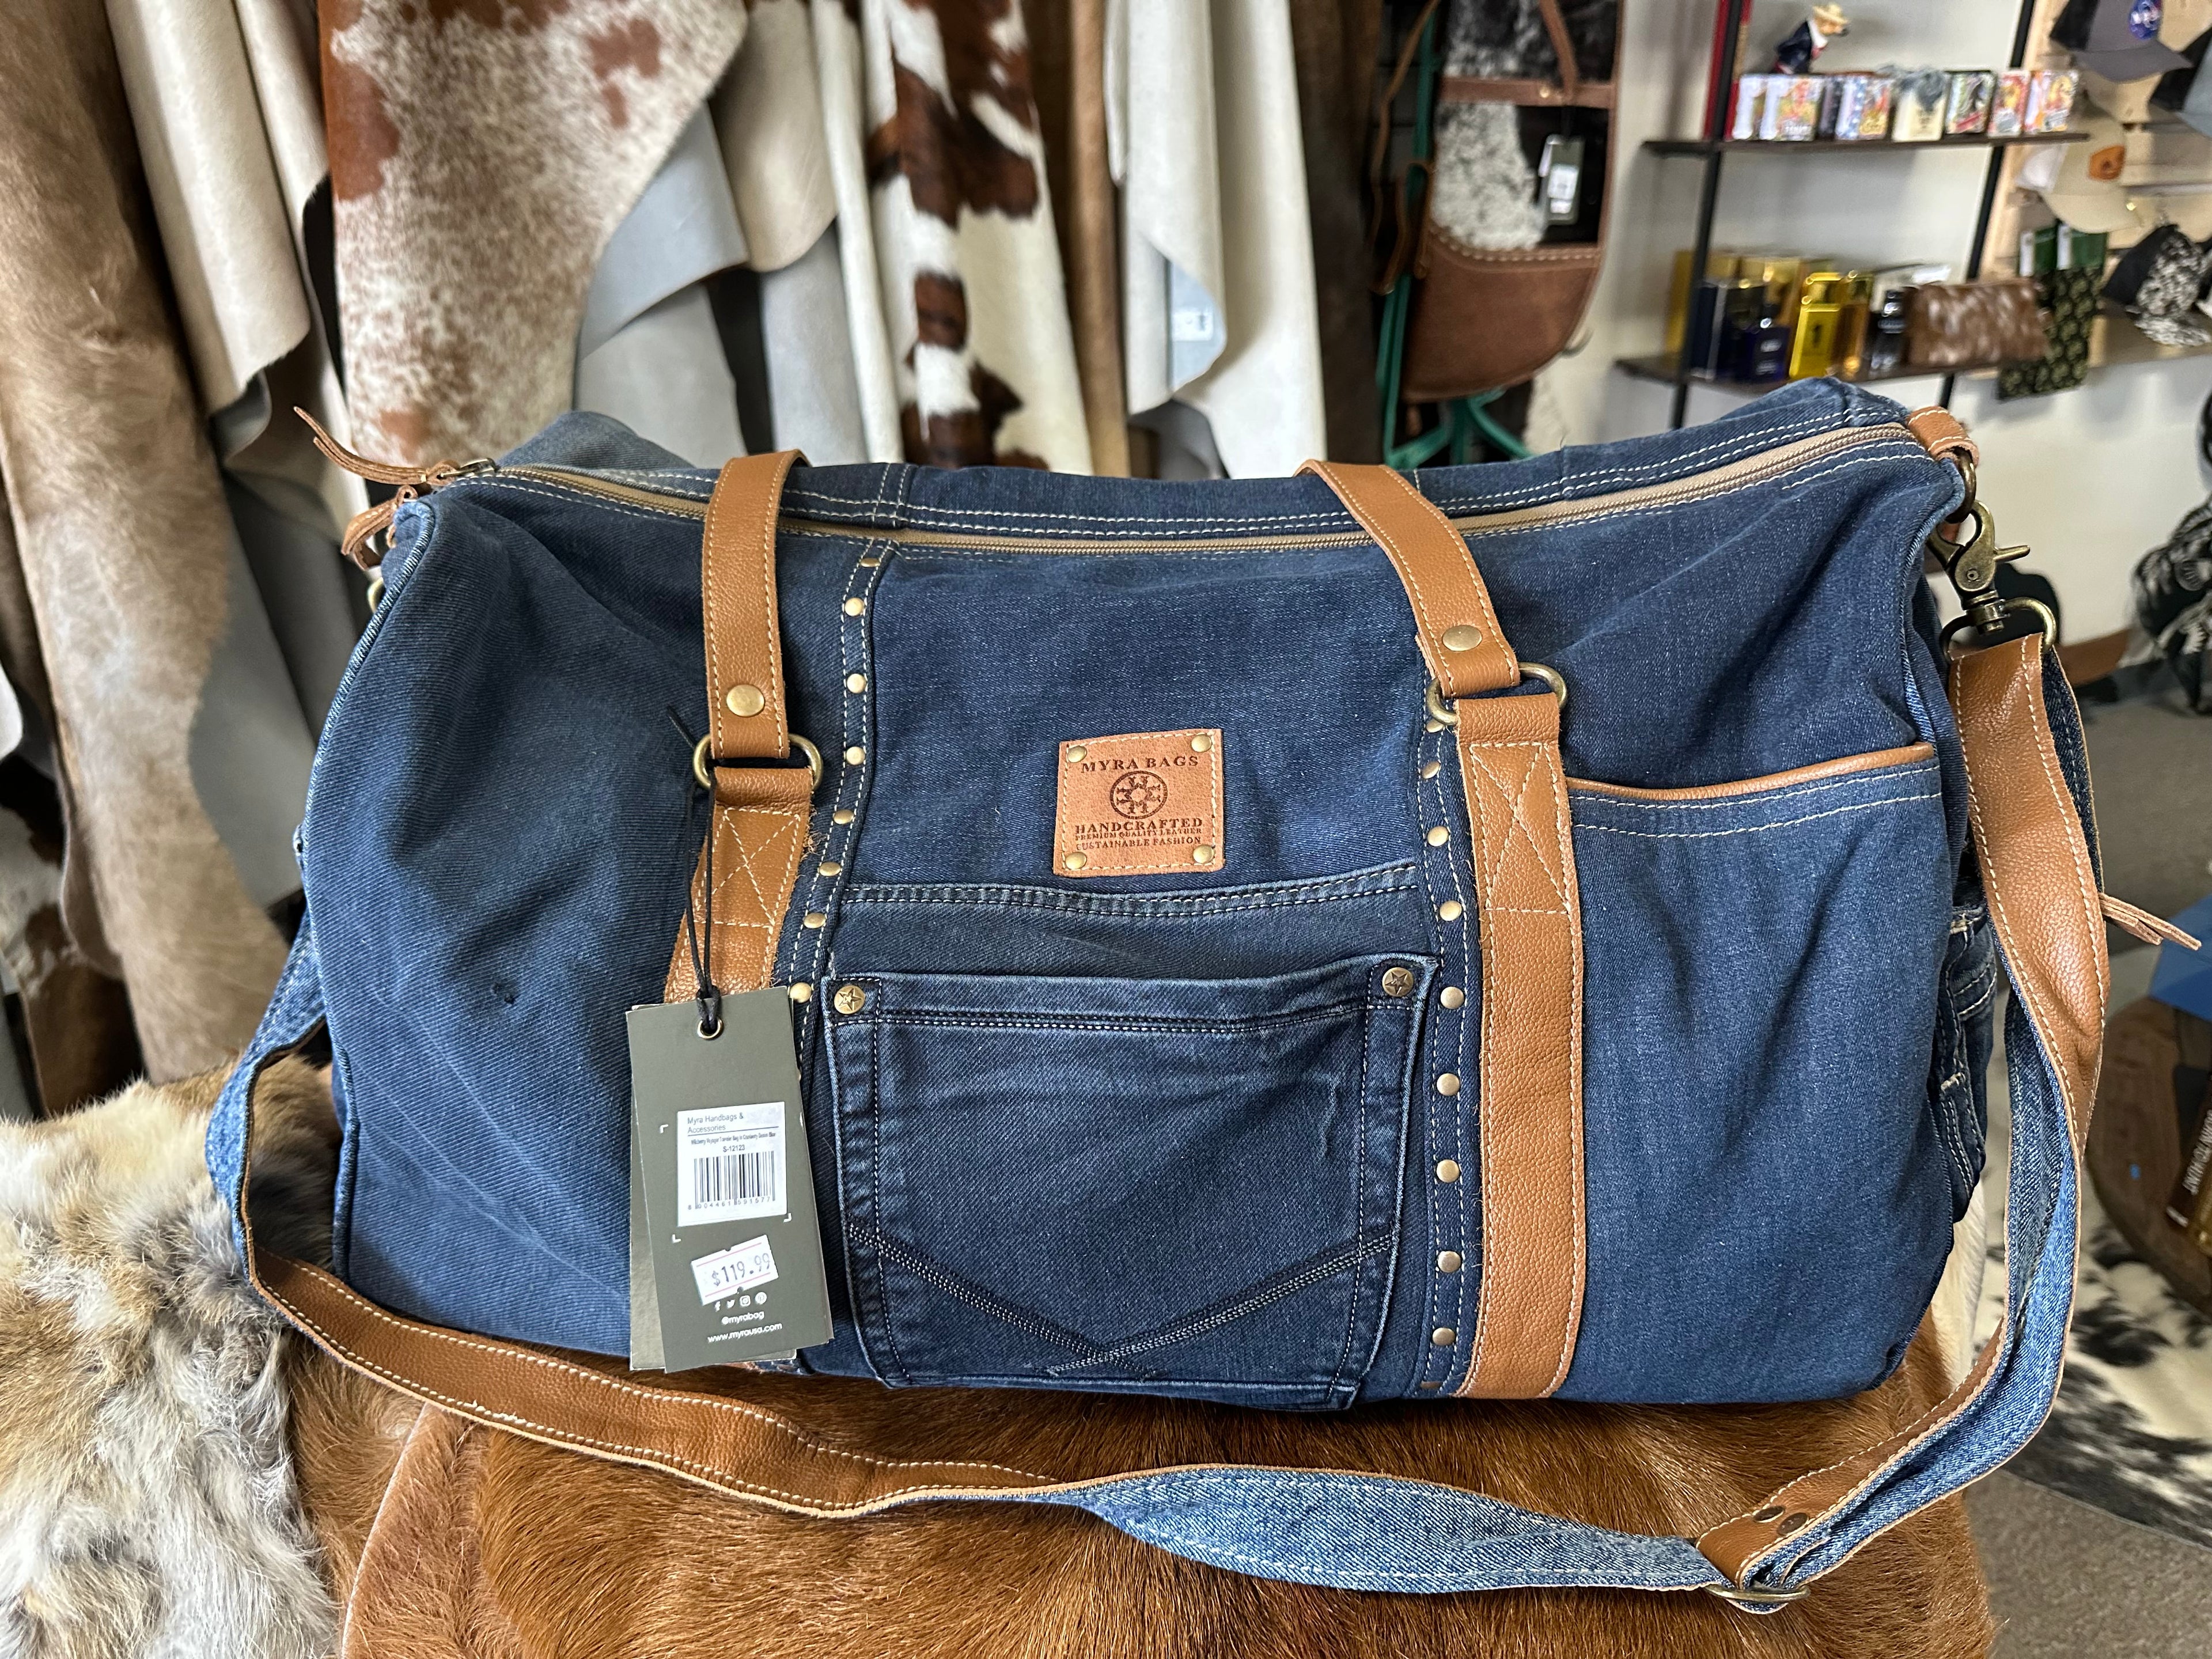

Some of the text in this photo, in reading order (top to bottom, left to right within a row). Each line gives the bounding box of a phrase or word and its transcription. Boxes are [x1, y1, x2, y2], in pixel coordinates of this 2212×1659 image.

[1081, 756, 1199, 774] MYRA BAGS
[1075, 817, 1203, 834] HANDCRAFTED
[1075, 832, 1116, 841] PREMIUM
[1119, 830, 1157, 839] QUALITY
[1076, 836, 1201, 851] SUSTAINABLE FASHION
[687, 1117, 703, 1125] Myra
[705, 1113, 737, 1122] Handbags
[687, 1124, 726, 1134] Accessories
[723, 1145, 745, 1153] S-12123
[711, 1253, 770, 1286] $119.99
[722, 1311, 765, 1325] @myrabag
[707, 1323, 783, 1343] www.myrausa.com
